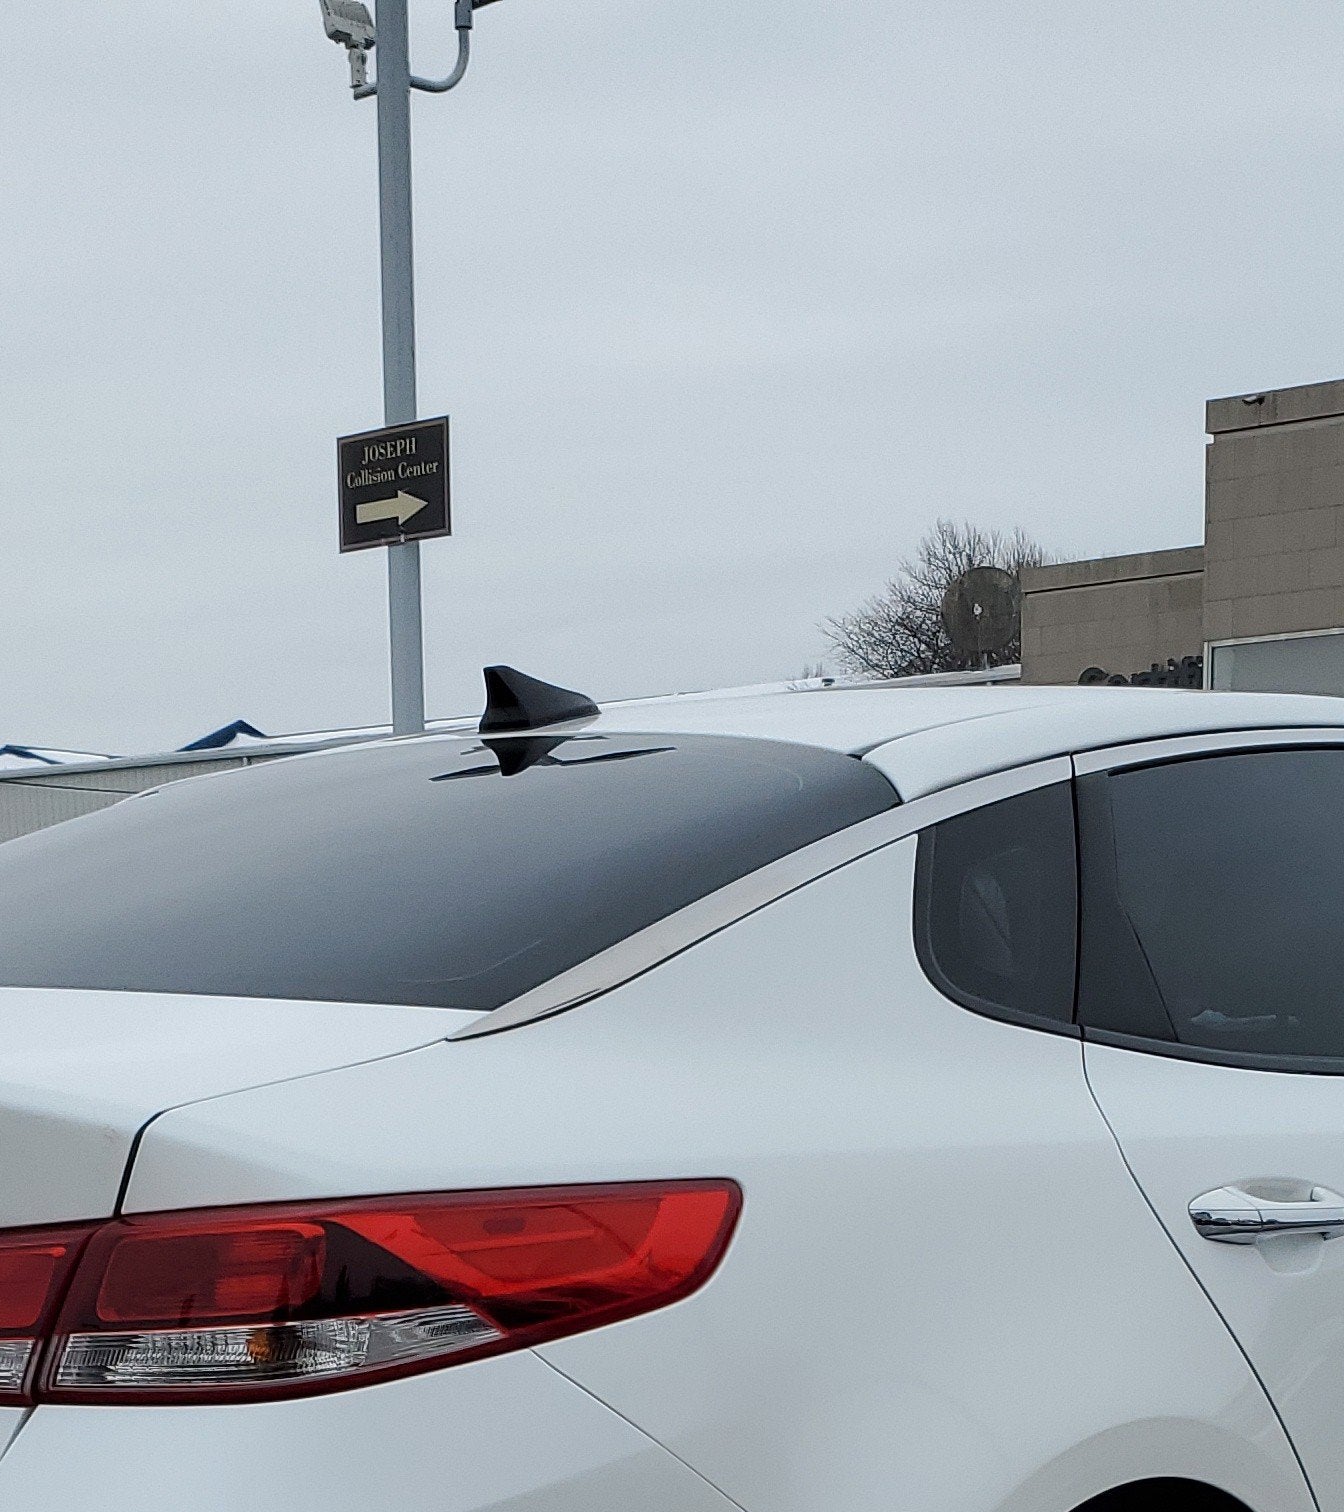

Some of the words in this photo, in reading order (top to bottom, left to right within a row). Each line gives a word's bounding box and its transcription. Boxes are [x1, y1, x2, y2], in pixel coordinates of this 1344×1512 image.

[362, 437, 416, 465] JOSEPH
[346, 468, 395, 489] Collision
[398, 461, 439, 479] Center
